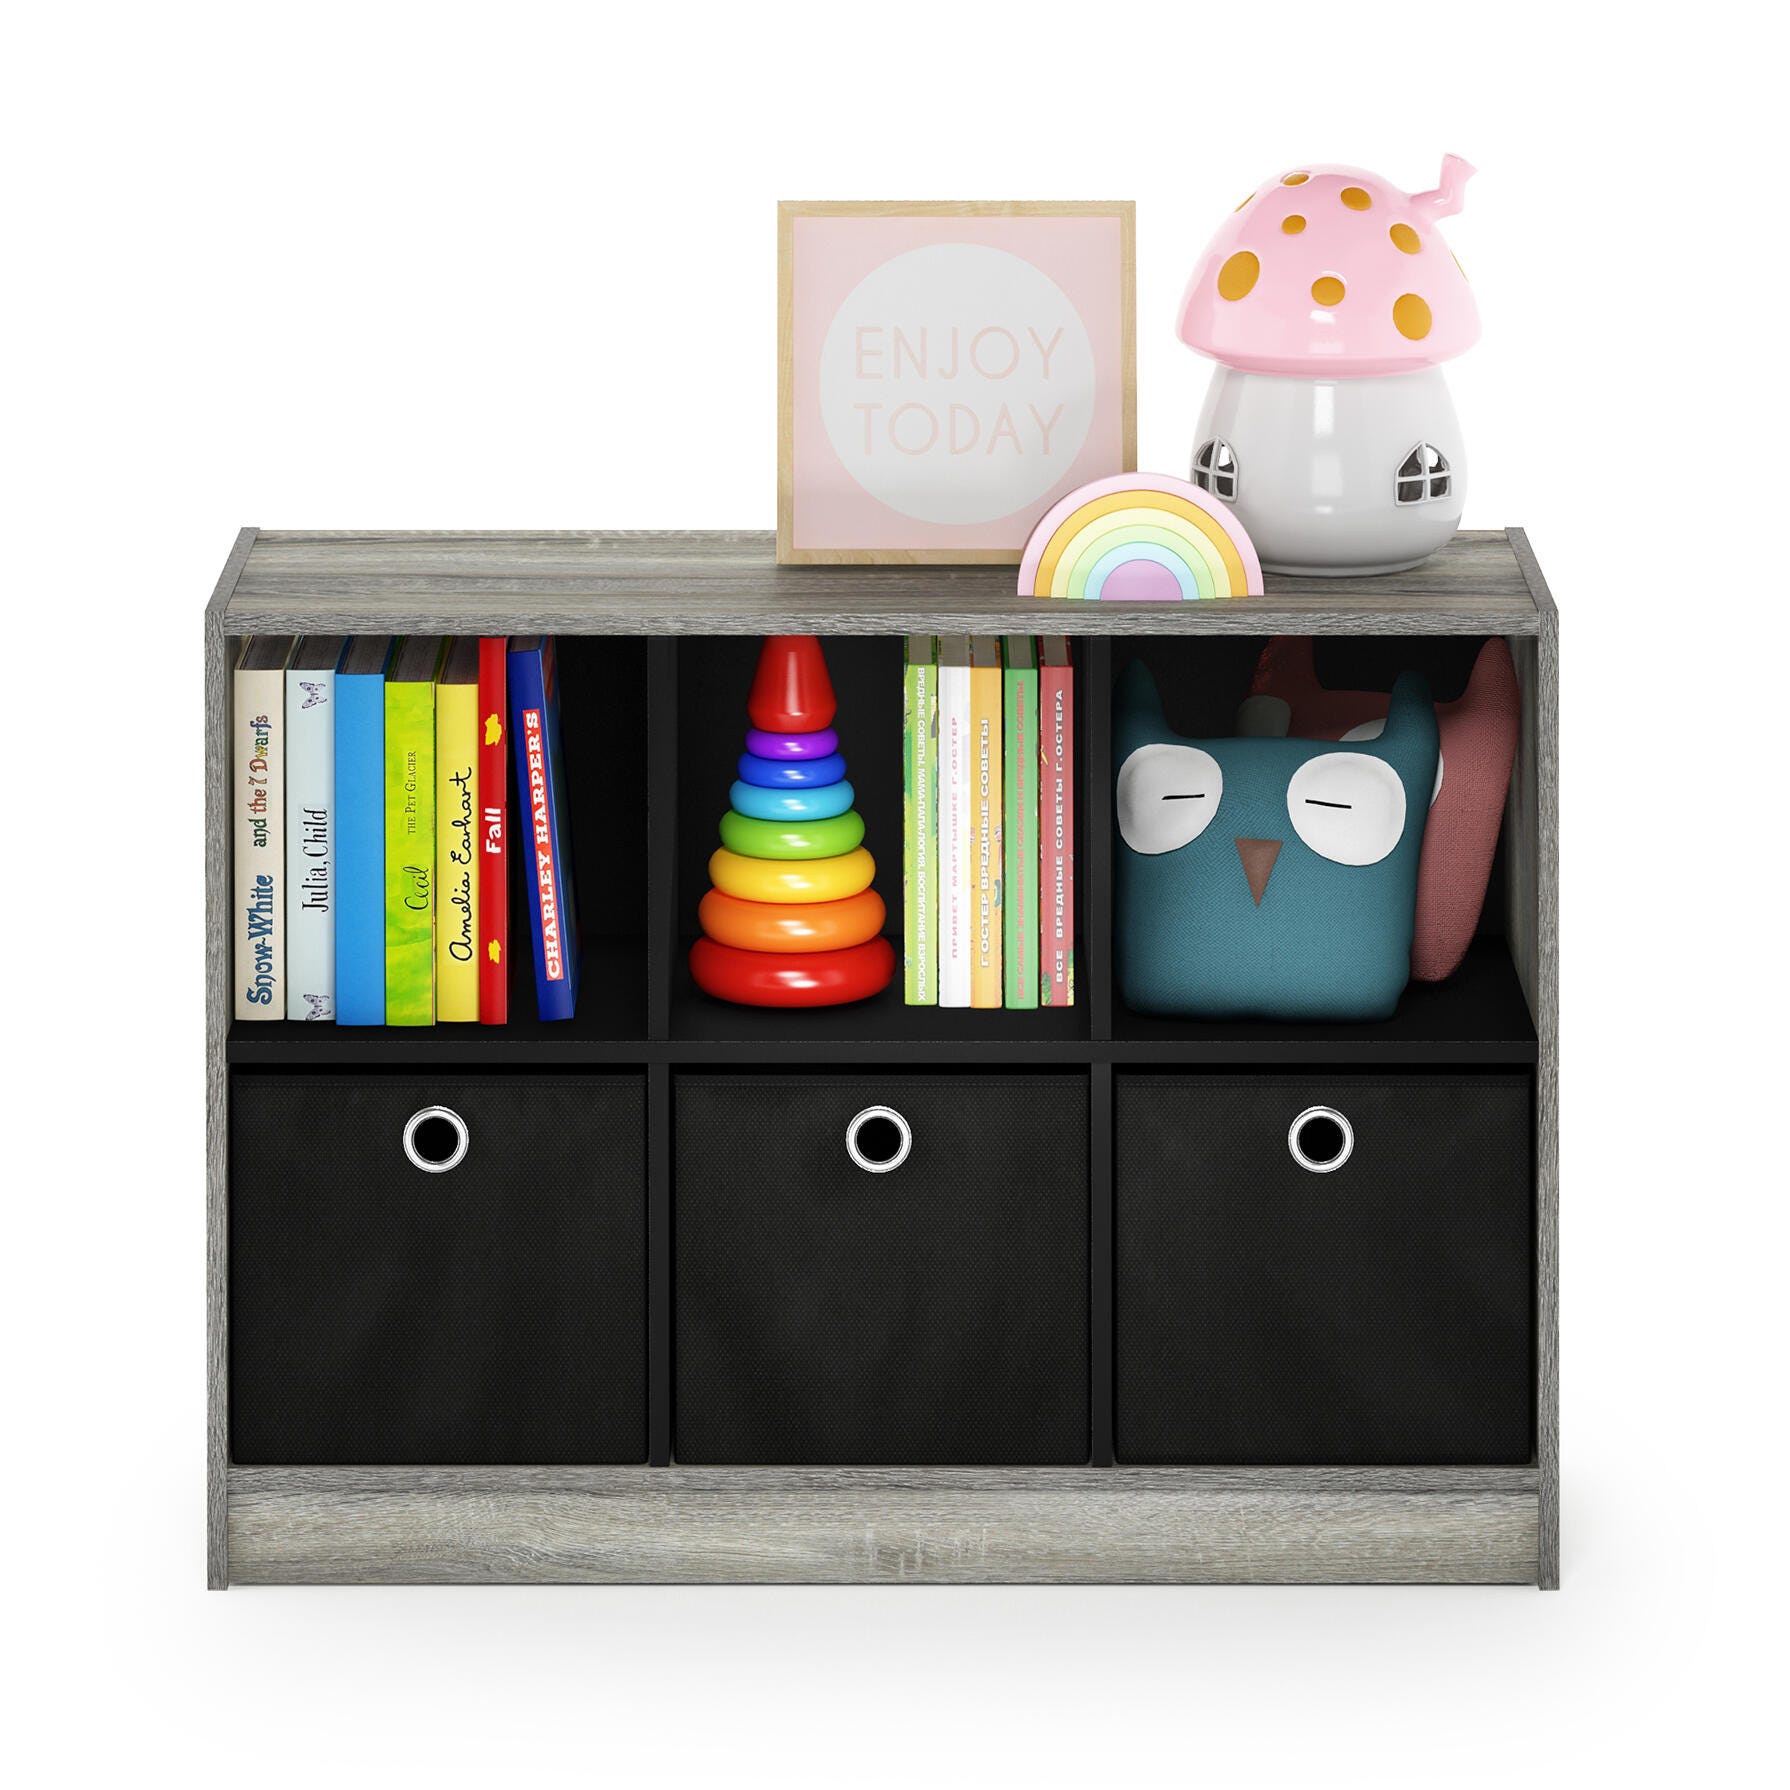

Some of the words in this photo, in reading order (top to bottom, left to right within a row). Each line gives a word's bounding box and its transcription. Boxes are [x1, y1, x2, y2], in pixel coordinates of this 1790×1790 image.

[854, 325, 1066, 381] ENJOY
[853, 401, 1066, 456] TODAY
[249, 714, 272, 773] Dwarfs
[981, 719, 990, 798] СОВЕТЫ
[247, 788, 267, 814] the
[248, 776, 268, 786] 7
[525, 711, 550, 844] HARPER'S
[248, 818, 270, 848] and
[303, 807, 329, 858] Child
[449, 766, 473, 865] Earhart
[484, 807, 502, 854] Fall
[1055, 778, 1064, 850] СОВЕТЫ
[981, 800, 991, 890] ВРЕДНЫЕ
[402, 866, 430, 911] Cecil
[449, 871, 473, 962] Amelia
[537, 850, 561, 979] CHARLEY
[1055, 855, 1065, 939] ВРЕДНЫЕ
[981, 893, 990, 953] ОСТЕР
[1056, 950, 1064, 983] ВСЕ
